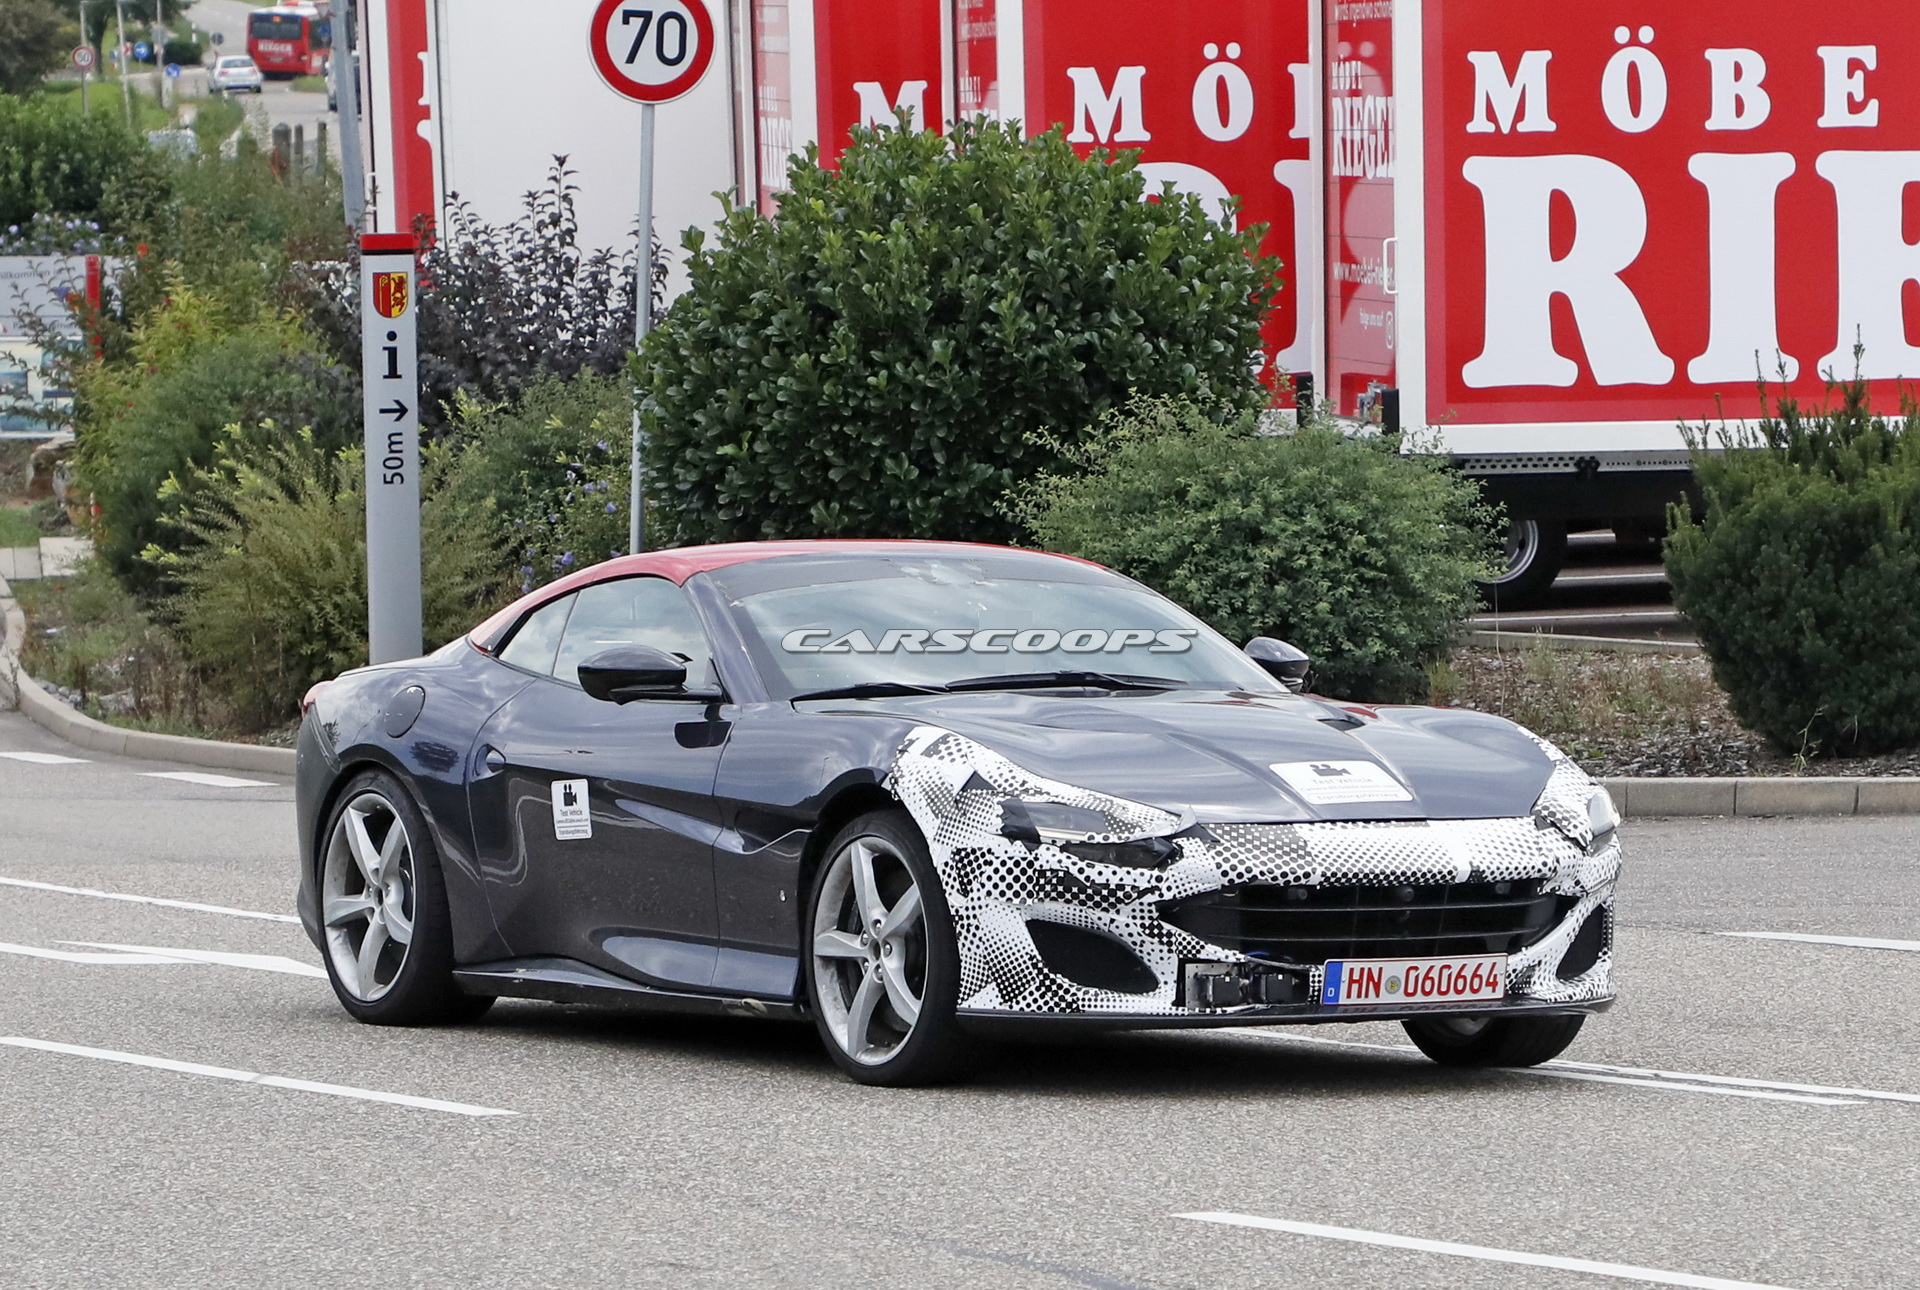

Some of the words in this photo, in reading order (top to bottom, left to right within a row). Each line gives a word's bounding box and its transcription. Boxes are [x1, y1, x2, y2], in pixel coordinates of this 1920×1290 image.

[622, 9, 687, 66] 70
[1066, 42, 1310, 144] MÖ
[1466, 25, 1879, 134] MÖBE
[383, 432, 404, 485] 50m
[1327, 987, 1335, 997] D
[1346, 967, 1383, 999] HN
[1404, 962, 1498, 997] 060664
